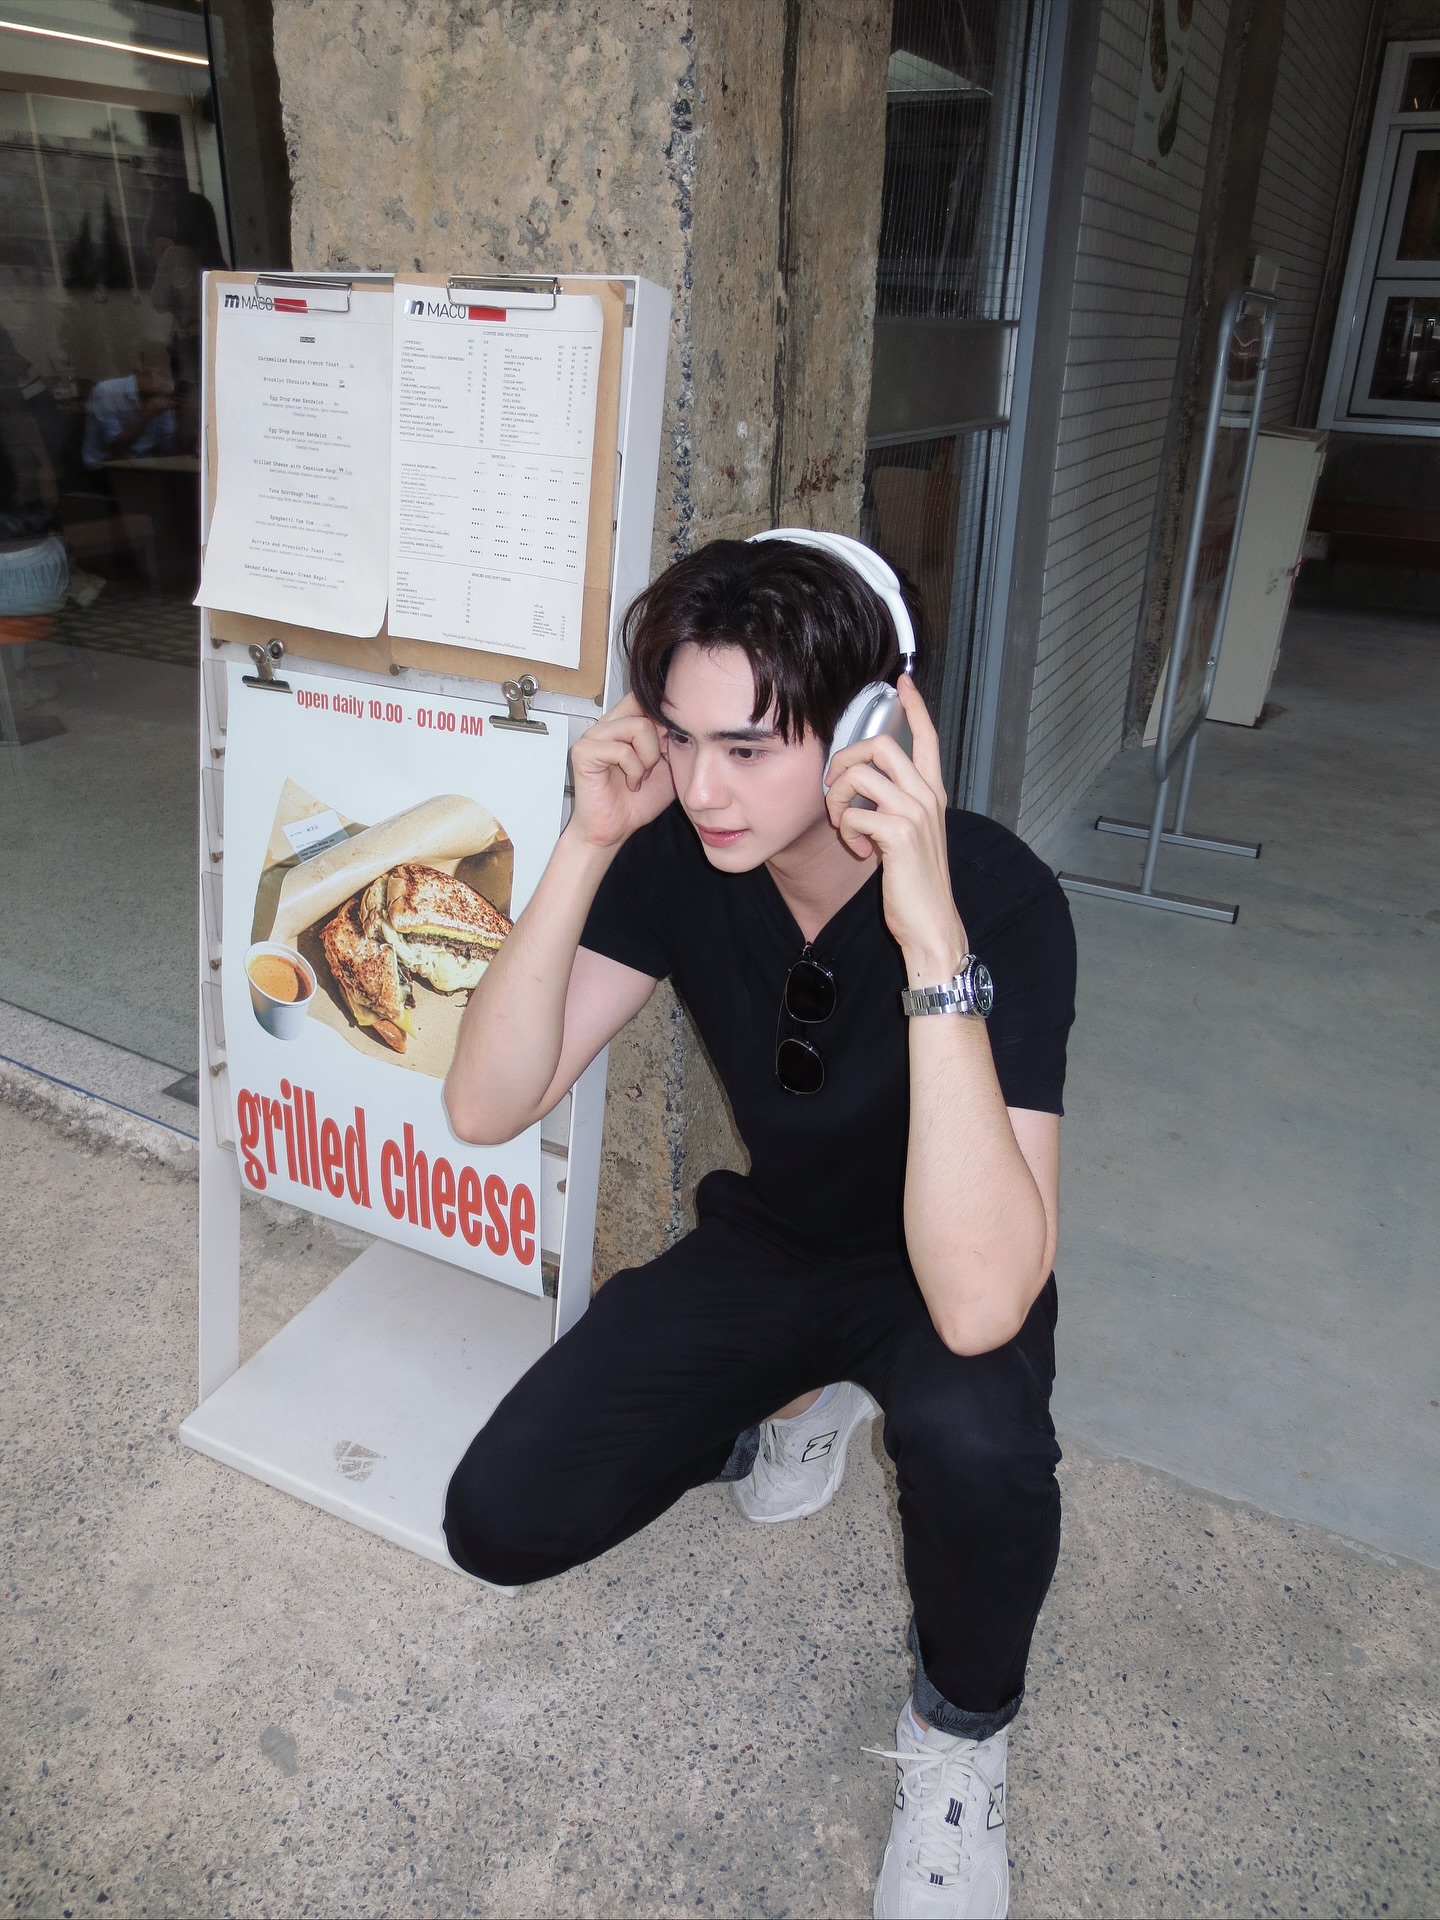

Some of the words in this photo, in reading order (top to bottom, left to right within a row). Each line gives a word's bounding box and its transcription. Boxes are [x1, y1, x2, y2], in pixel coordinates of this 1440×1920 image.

[241, 295, 273, 311] MACO
[427, 302, 466, 319] MACO
[296, 689, 329, 711] open
[333, 694, 364, 719] daily
[368, 700, 403, 724] 10.00
[416, 708, 456, 733] 01.00
[460, 714, 483, 737] AM
[237, 1078, 372, 1209] grilled
[380, 1122, 536, 1266] cheese
